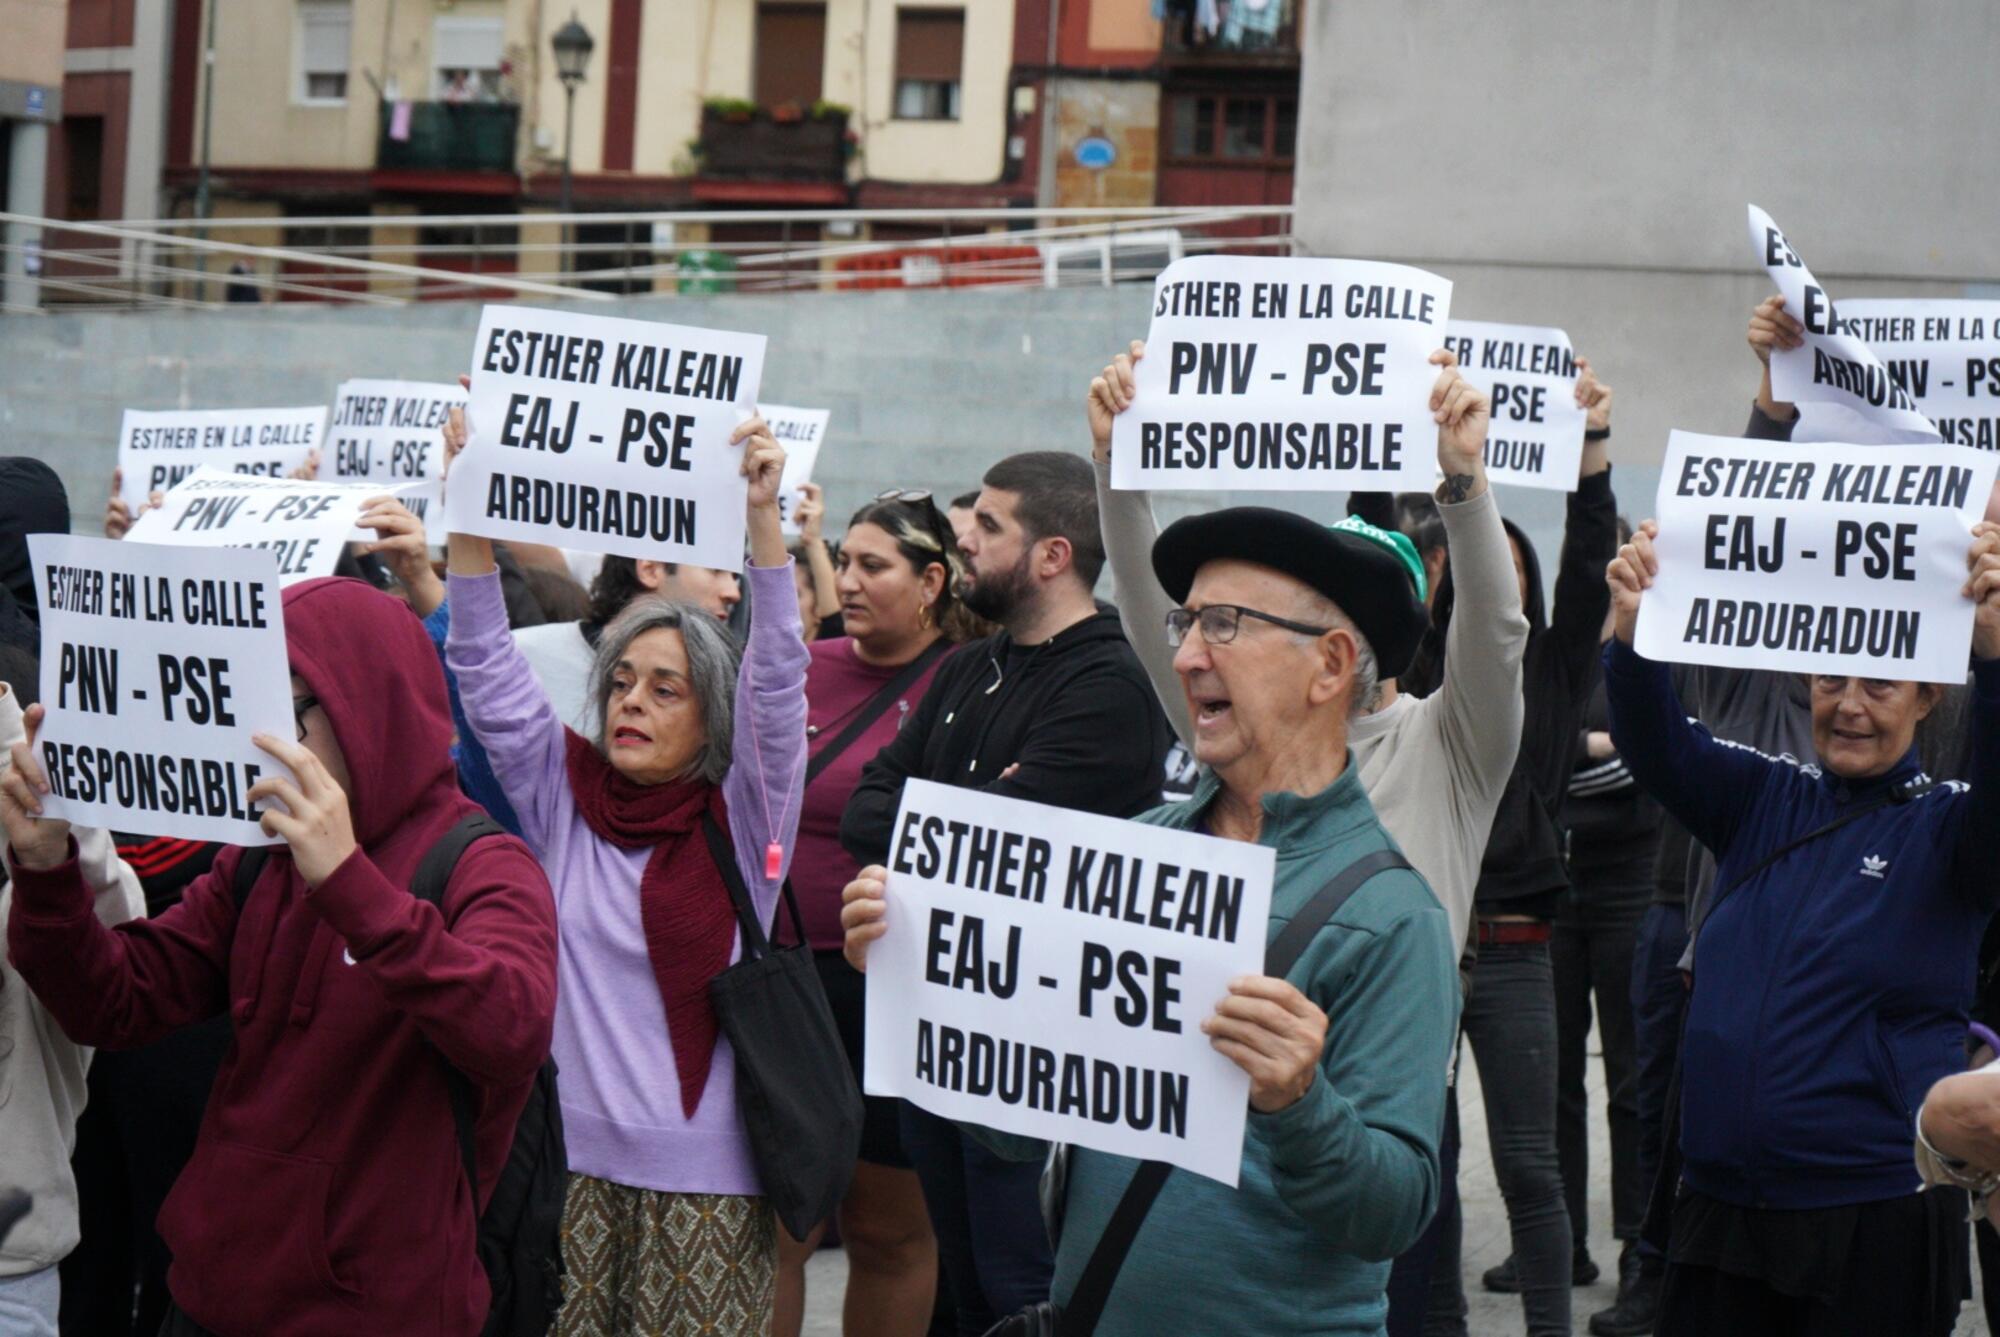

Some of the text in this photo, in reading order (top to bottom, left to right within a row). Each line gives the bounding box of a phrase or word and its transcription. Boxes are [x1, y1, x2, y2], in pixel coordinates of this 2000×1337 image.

[1252, 283, 1288, 319] EN
[1301, 284, 1333, 319] LA
[1345, 284, 1435, 325] CALLE
[1924, 318, 1950, 341] EN
[1959, 318, 1984, 341] LA
[482, 328, 743, 402] ESTHER KALEAN
[1169, 342, 1257, 395] PNV
[1302, 343, 1387, 396] PSE
[1481, 340, 1577, 378] KALEAN
[389, 398, 467, 428] KALEA
[1490, 382, 1547, 423] PSE
[131, 423, 315, 449] ESTHER EN LA CALLE
[336, 439, 371, 477] EAJ
[391, 439, 431, 478] PSE
[500, 393, 580, 454] EAJ
[616, 408, 696, 471] PSE
[1141, 422, 1403, 471] RESPONSABLE
[486, 472, 696, 546] ARDURADUN
[1676, 455, 1973, 509] ESTHER KALEAN
[173, 496, 250, 531] PNV
[263, 496, 340, 523] PSE
[1704, 514, 1786, 573] EAJ
[1834, 520, 1918, 581] PSE
[46, 565, 267, 629] ESTHER EN LA CALLE
[1683, 597, 1920, 659] ARDURADUN
[58, 642, 118, 716] PNV
[157, 653, 236, 727] PSE
[42, 740, 265, 822] RESPONSABLE
[893, 811, 1245, 944] ESTHER KALEAN
[925, 908, 1022, 1000] EAJ
[1078, 941, 1182, 1035] PSE
[916, 1018, 1189, 1140] ARDURADUN
